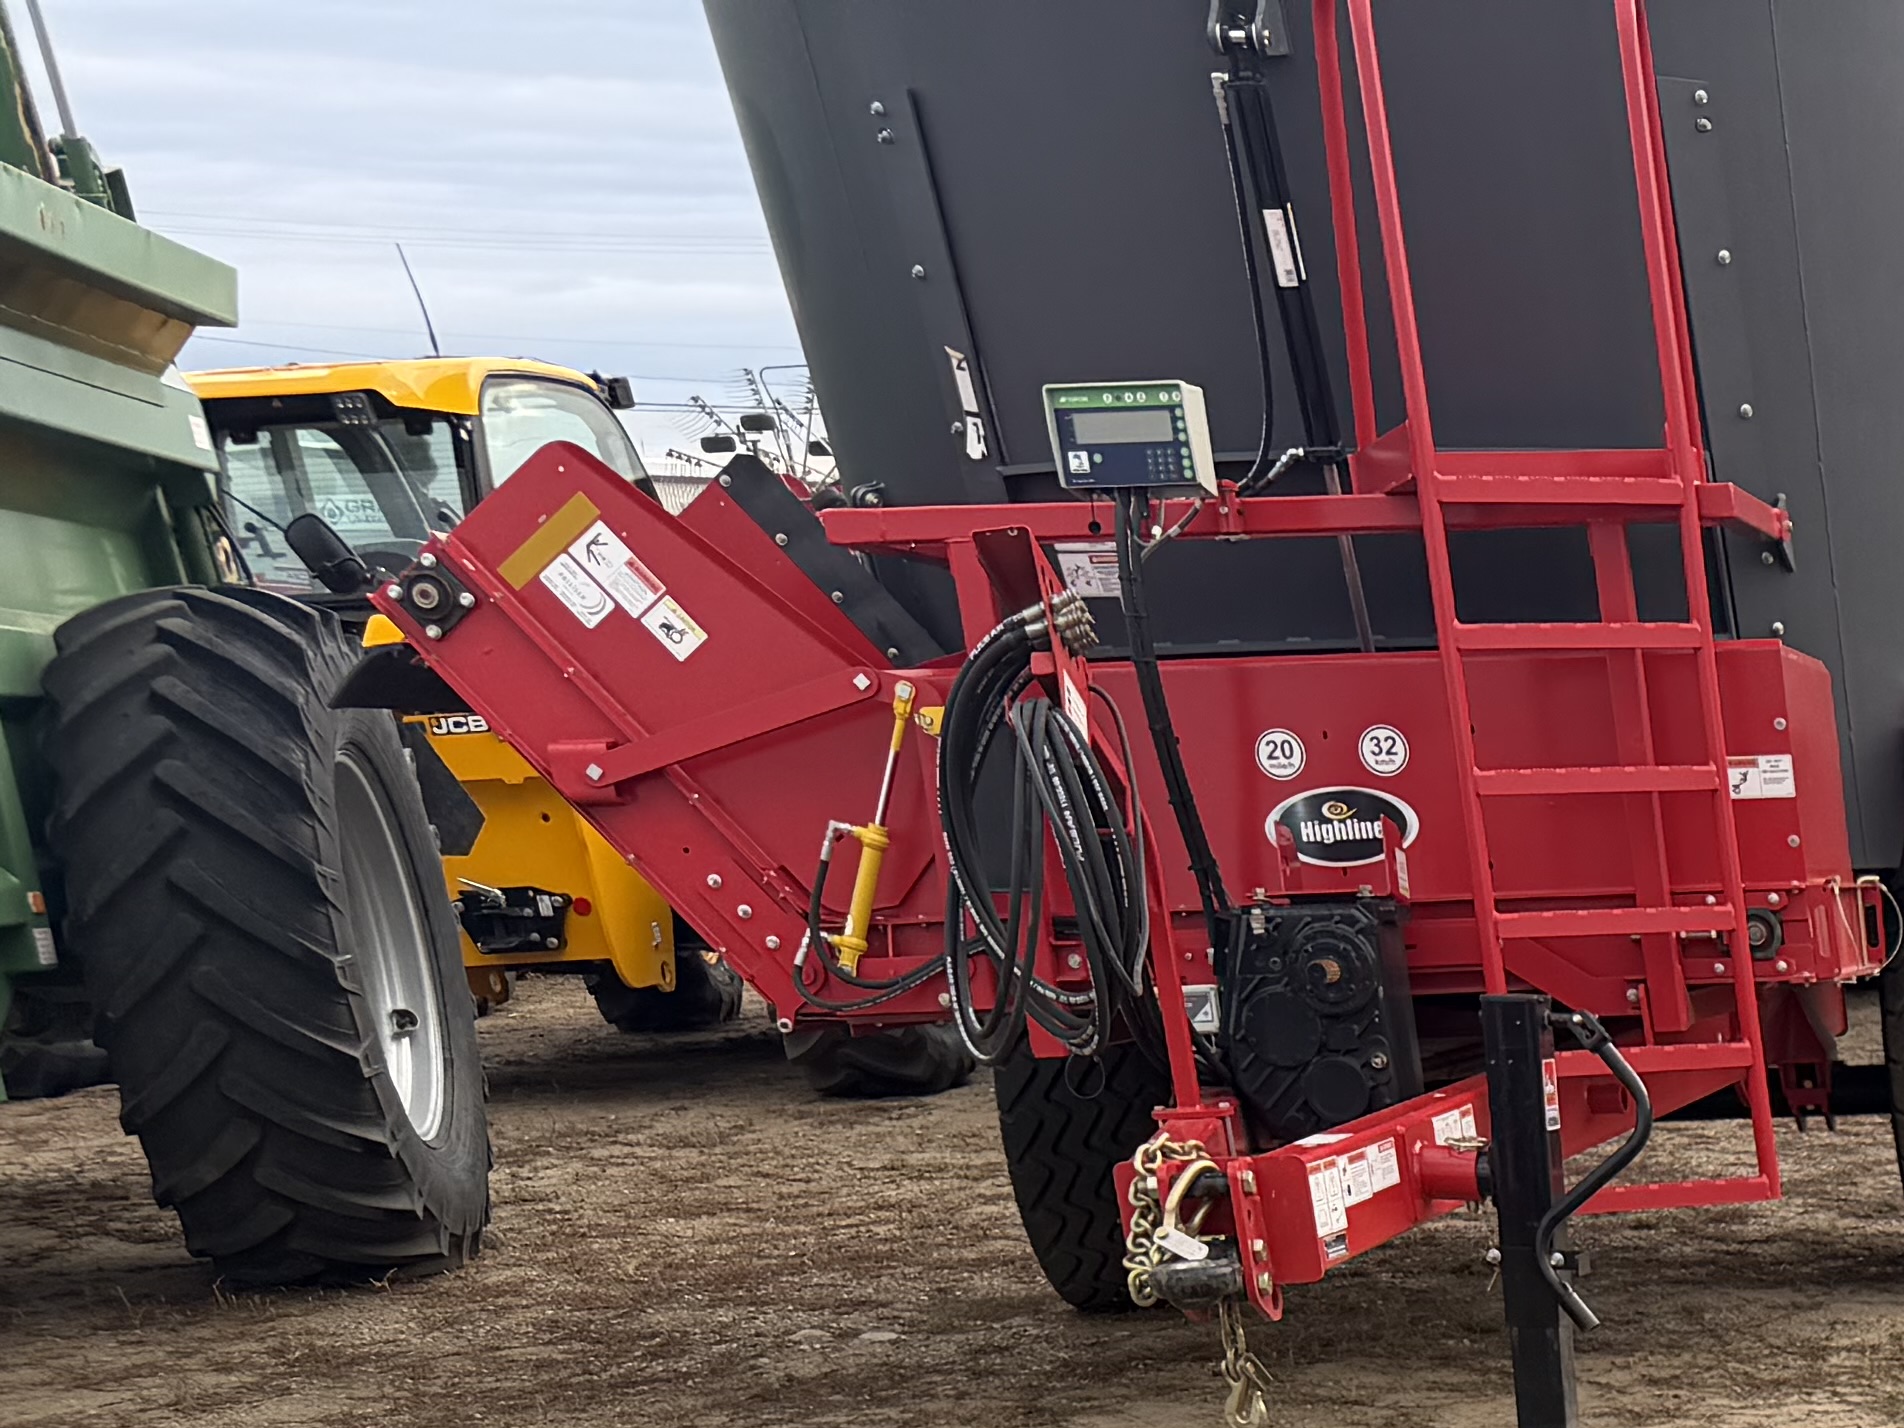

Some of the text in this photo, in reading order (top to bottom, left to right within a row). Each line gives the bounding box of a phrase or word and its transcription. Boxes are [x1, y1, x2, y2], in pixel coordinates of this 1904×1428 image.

[430, 715, 489, 735] JCB
[1264, 739, 1295, 760] 20
[1369, 735, 1399, 757] 32
[1300, 818, 1385, 844] Highline
